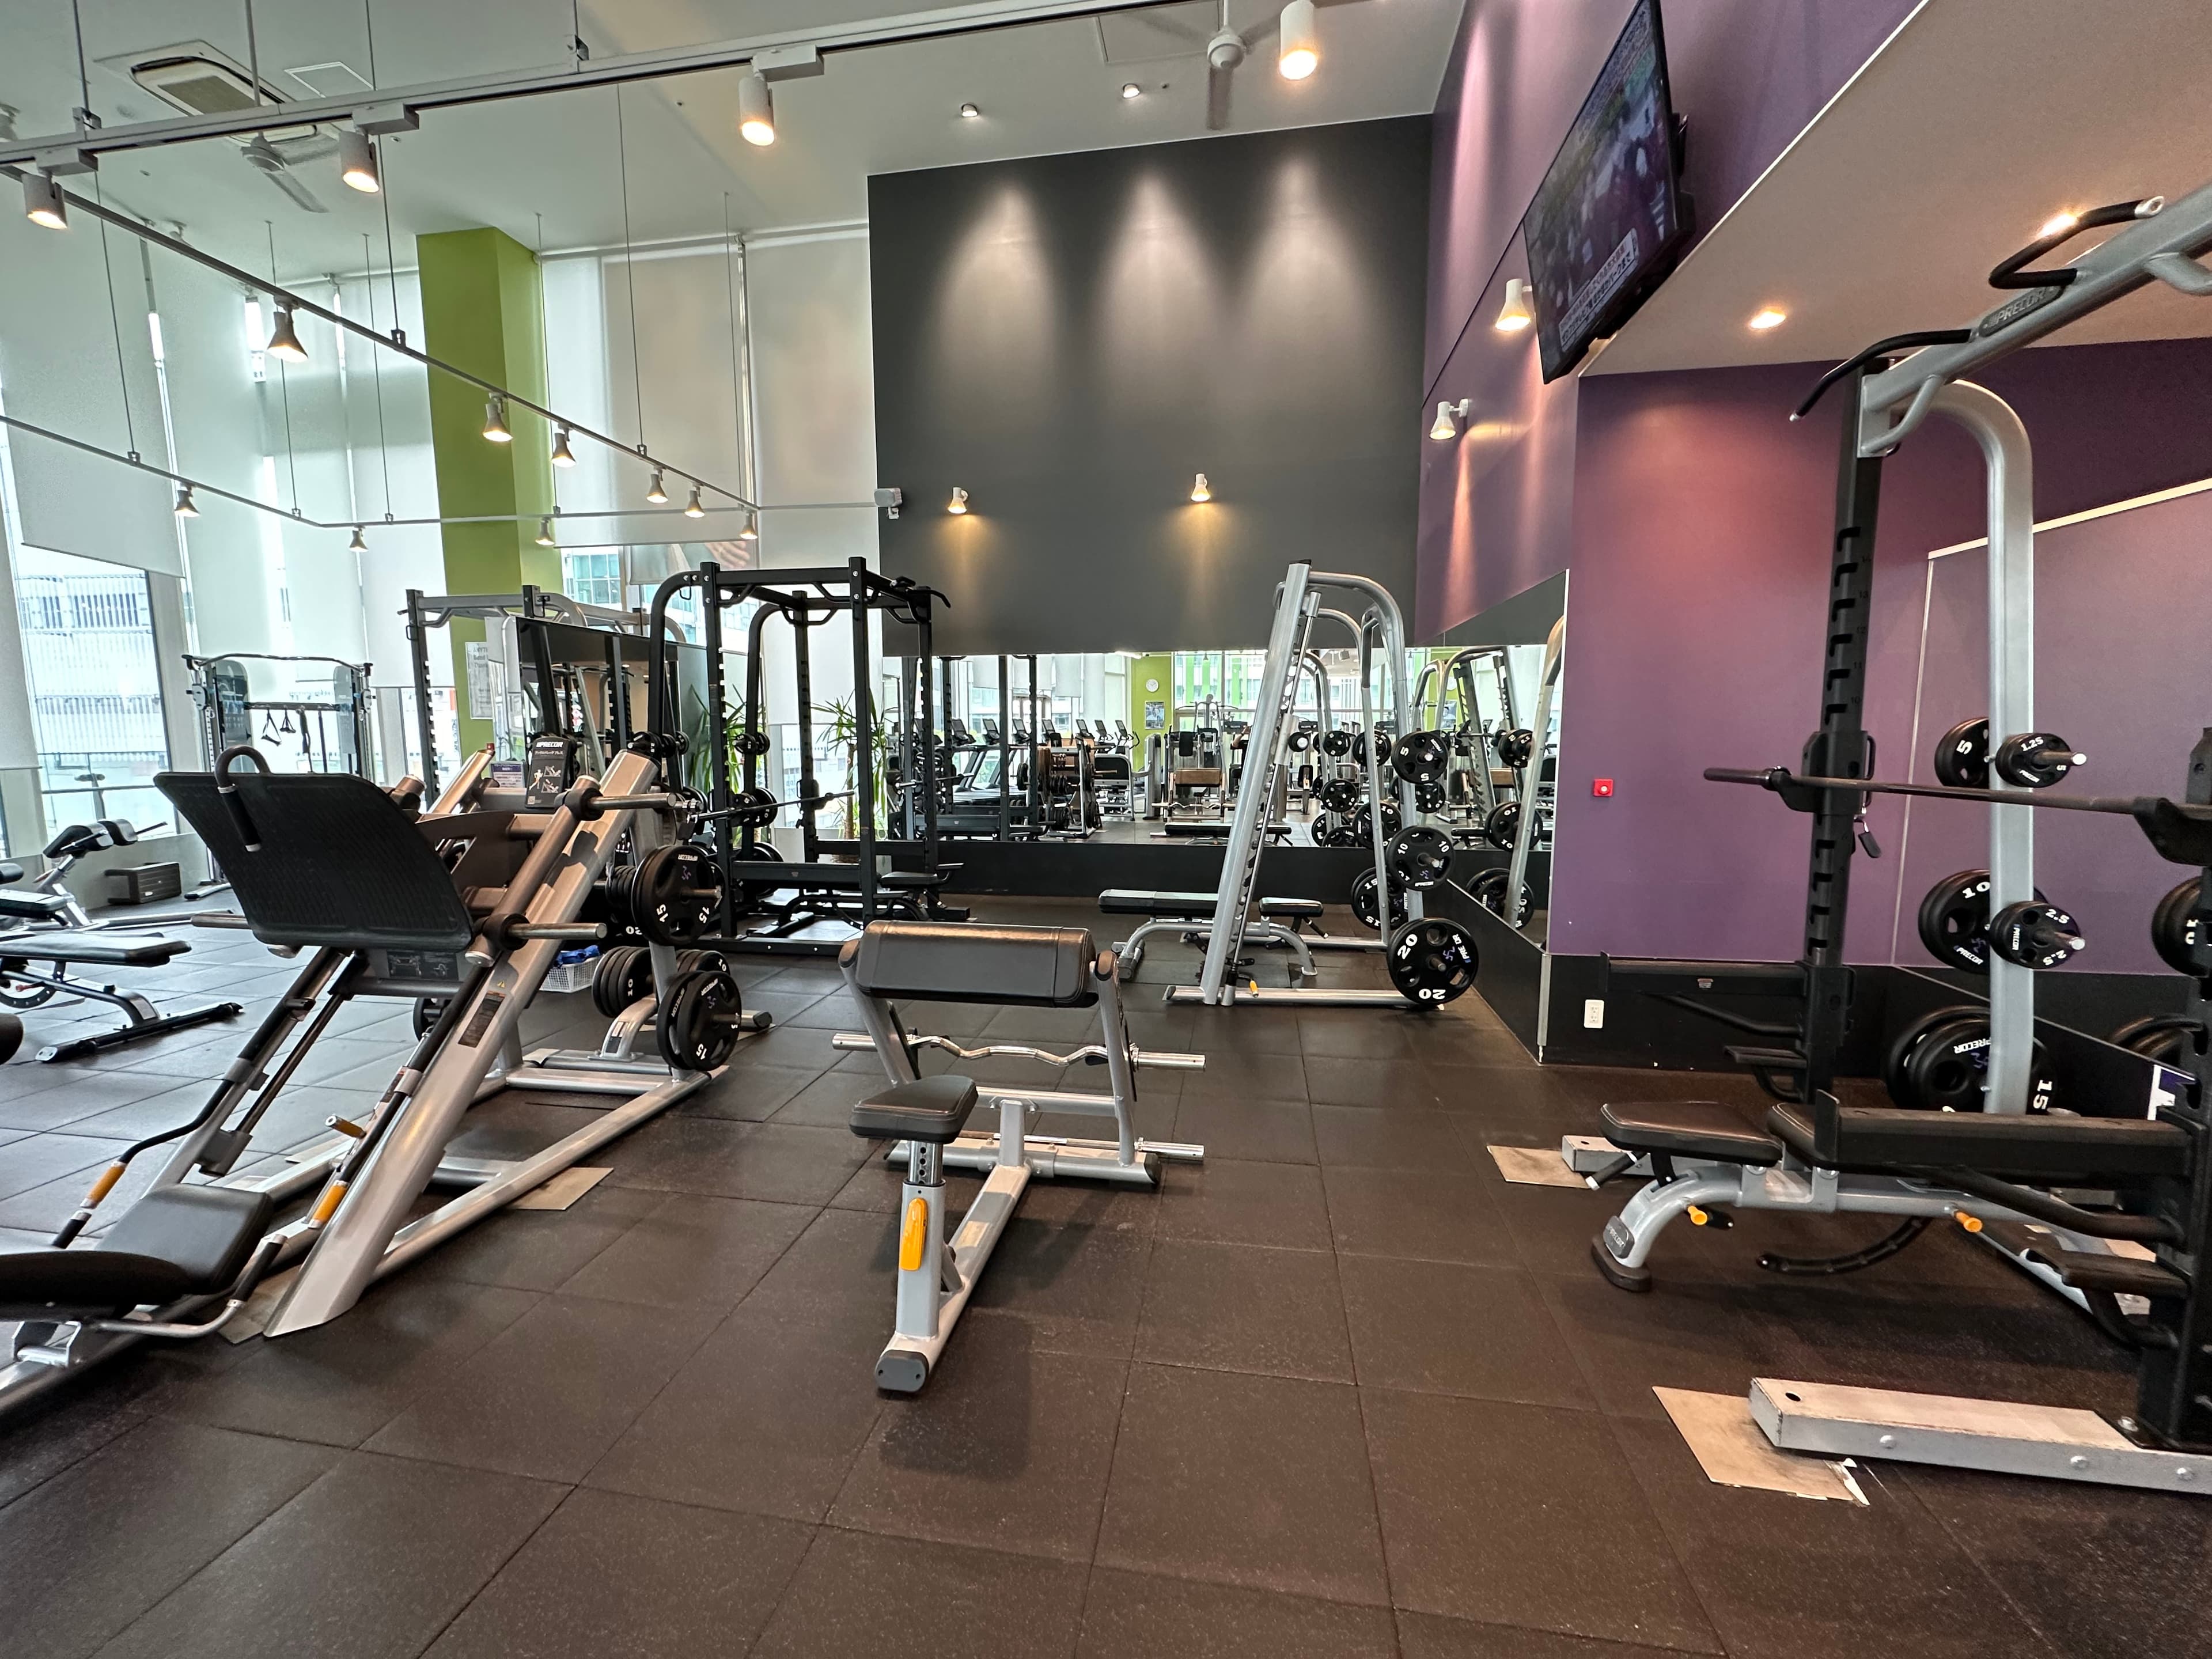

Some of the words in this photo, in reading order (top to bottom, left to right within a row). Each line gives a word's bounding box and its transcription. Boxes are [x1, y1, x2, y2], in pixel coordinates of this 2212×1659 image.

[1996, 289, 2047, 321] PRECOR
[1956, 740, 1972, 755] 5
[2021, 736, 2044, 751] 1.25
[1400, 747, 1409, 756] 5
[1421, 773, 1429, 781] 5
[1397, 843, 1408, 854] 10
[1439, 840, 1449, 853] 10
[1364, 878, 1378, 889] 15
[1962, 881, 1990, 899] 10
[656, 904, 669, 922] 15
[699, 907, 709, 923] 15
[2045, 909, 2070, 924] 2.5
[1397, 934, 1418, 960] 20
[1956, 946, 1983, 965] PRECOR
[2043, 950, 2067, 965] 2.5
[718, 959, 726, 971] 10
[1419, 988, 1446, 999] 20
[696, 1043, 707, 1060] 15
[2033, 1080, 2052, 1109] 15
